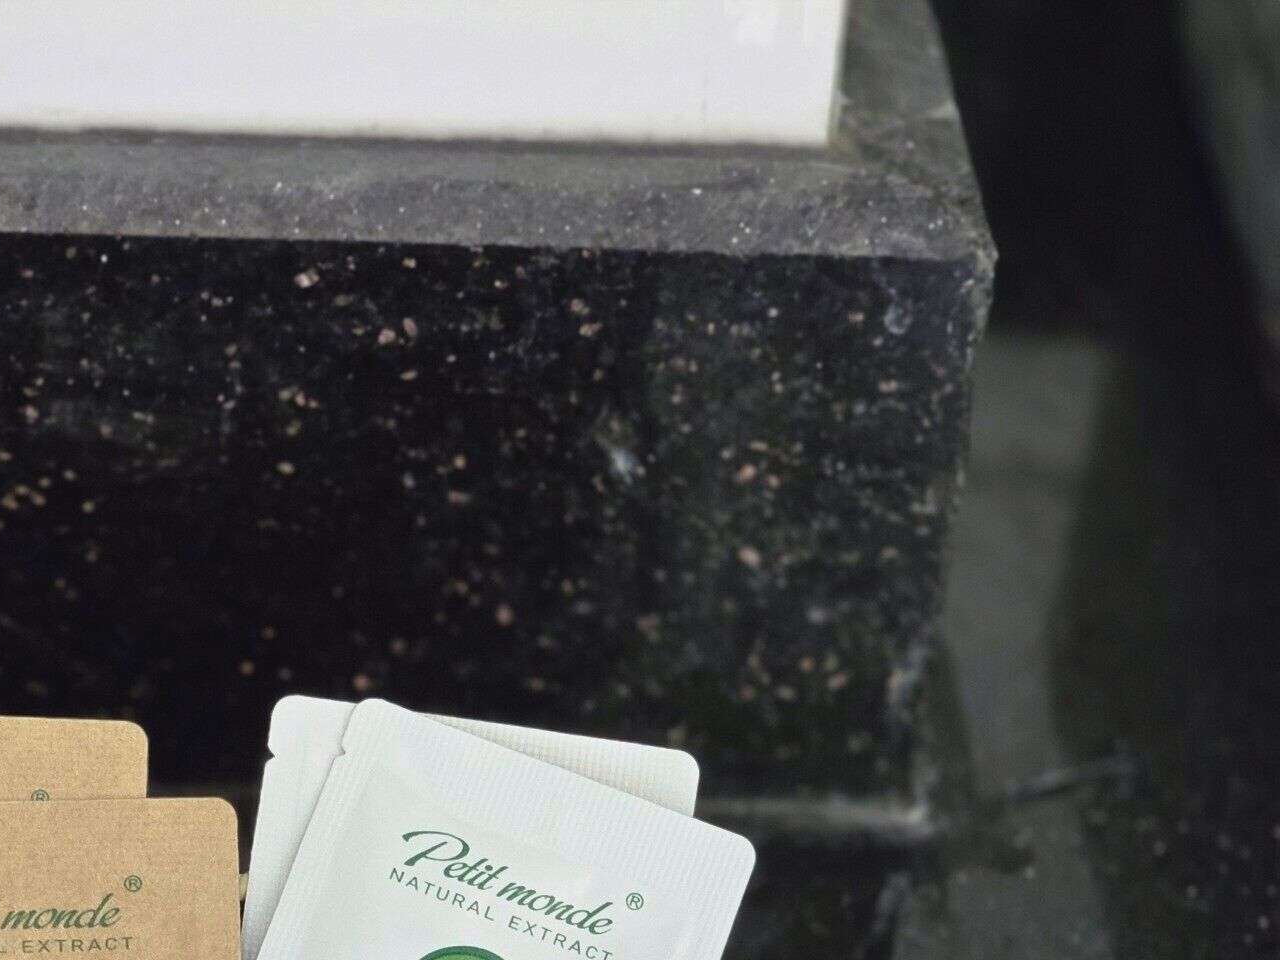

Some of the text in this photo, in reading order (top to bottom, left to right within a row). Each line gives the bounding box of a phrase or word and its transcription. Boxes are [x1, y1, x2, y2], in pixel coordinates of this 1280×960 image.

[389, 867, 495, 922] NATURAL
[401, 830, 508, 890] Petit
[496, 881, 614, 935] monde
[0, 892, 121, 931] monde
[23, 936, 134, 954] EXTRACT
